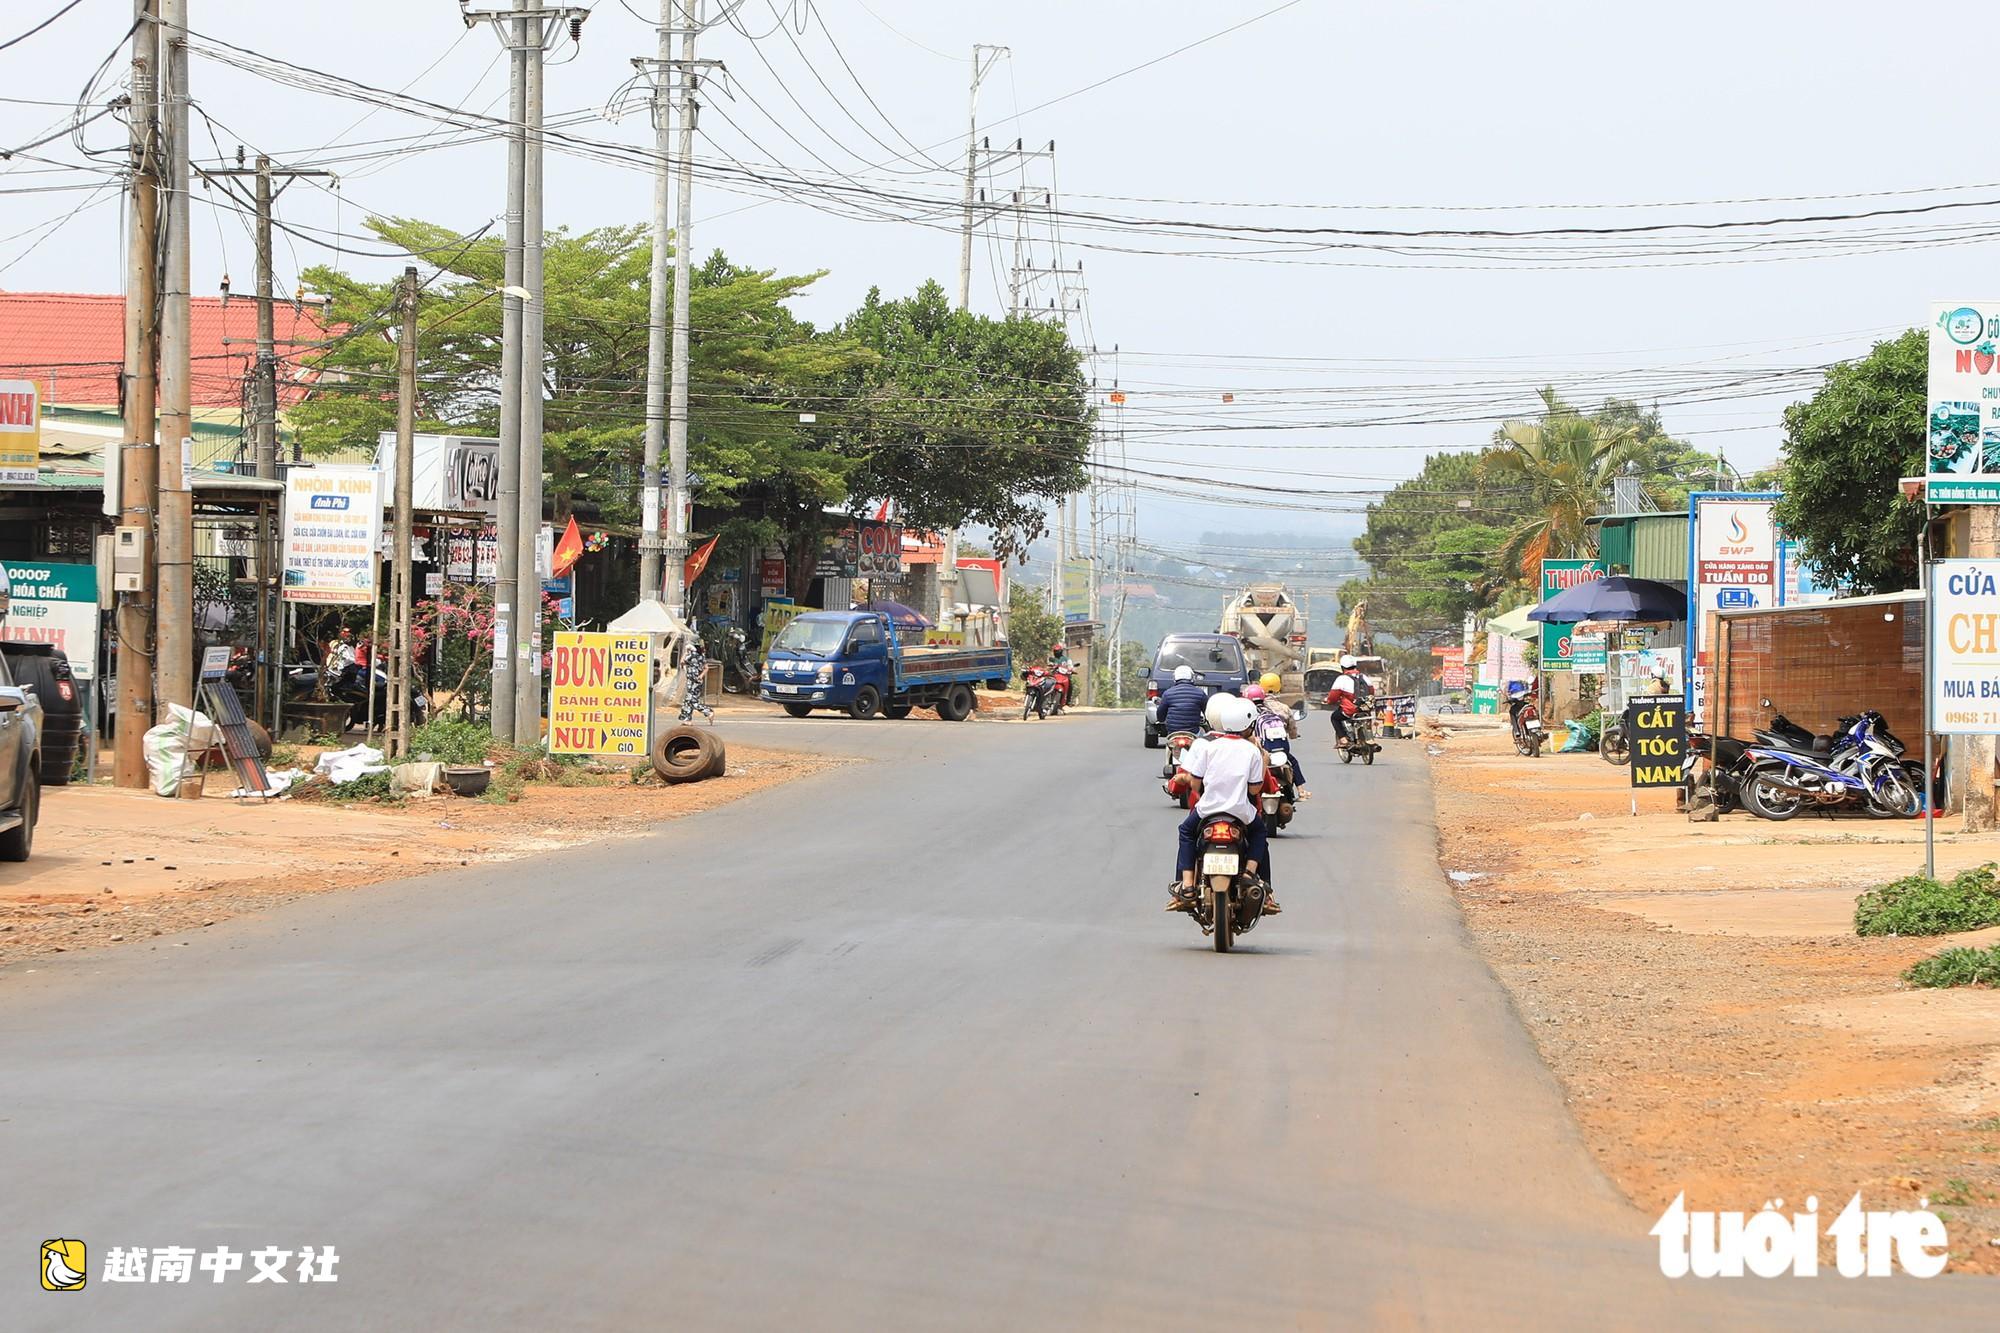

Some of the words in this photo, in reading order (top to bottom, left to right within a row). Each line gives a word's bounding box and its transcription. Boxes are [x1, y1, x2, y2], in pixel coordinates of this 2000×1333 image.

[294, 477, 333, 493] NHÔM
[339, 477, 372, 494] KÍNH
[314, 497, 331, 508] Anh
[332, 498, 346, 508] Phi
[1719, 546, 1755, 555] SWP
[8, 568, 51, 581] 00007
[1705, 570, 1744, 583] TUẤN
[1748, 573, 1768, 583] DO
[1948, 566, 1996, 596] CỬA
[13, 583, 37, 598] HÓA
[39, 583, 68, 599] CHẤT
[12, 605, 48, 619] NGHIỆP
[1948, 612, 2000, 655] CH
[555, 634, 606, 687] BÚN
[615, 639, 648, 650] RIÊU
[614, 654, 646, 664] MỌC
[1944, 680, 1975, 699] MUA
[559, 693, 598, 706] BÁNH
[604, 697, 642, 707] CANH
[1637, 705, 1676, 729] CẮT
[1945, 711, 1978, 724] 0968
[1983, 711, 2000, 724] 71
[555, 727, 595, 749] NUI
[610, 727, 643, 738] XƯƠNG
[1637, 735, 1679, 756] TÓC
[1635, 765, 1682, 784] NAM
